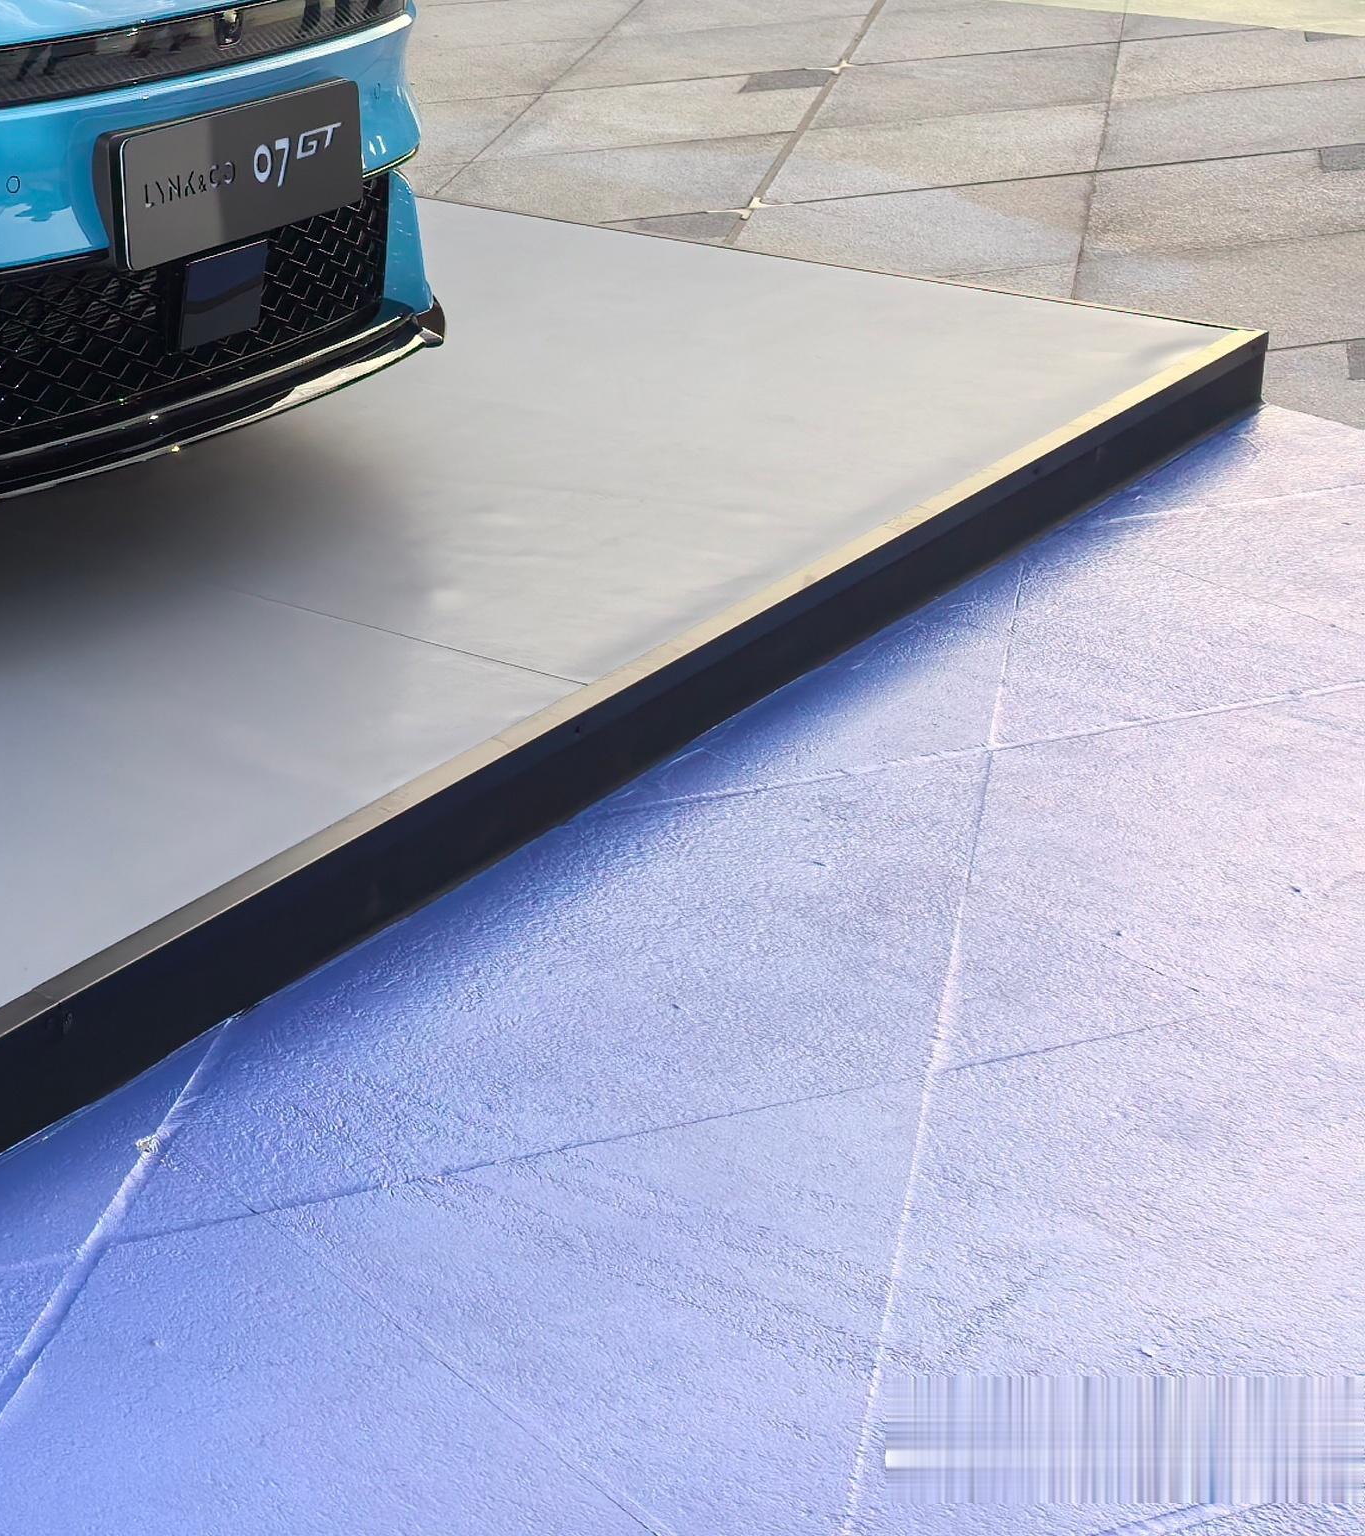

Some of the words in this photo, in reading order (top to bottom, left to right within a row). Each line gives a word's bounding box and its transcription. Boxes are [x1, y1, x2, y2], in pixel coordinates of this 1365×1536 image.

[144, 161, 236, 208] LYNK&CO
[253, 137, 290, 188] 07
[296, 122, 342, 160] GT
